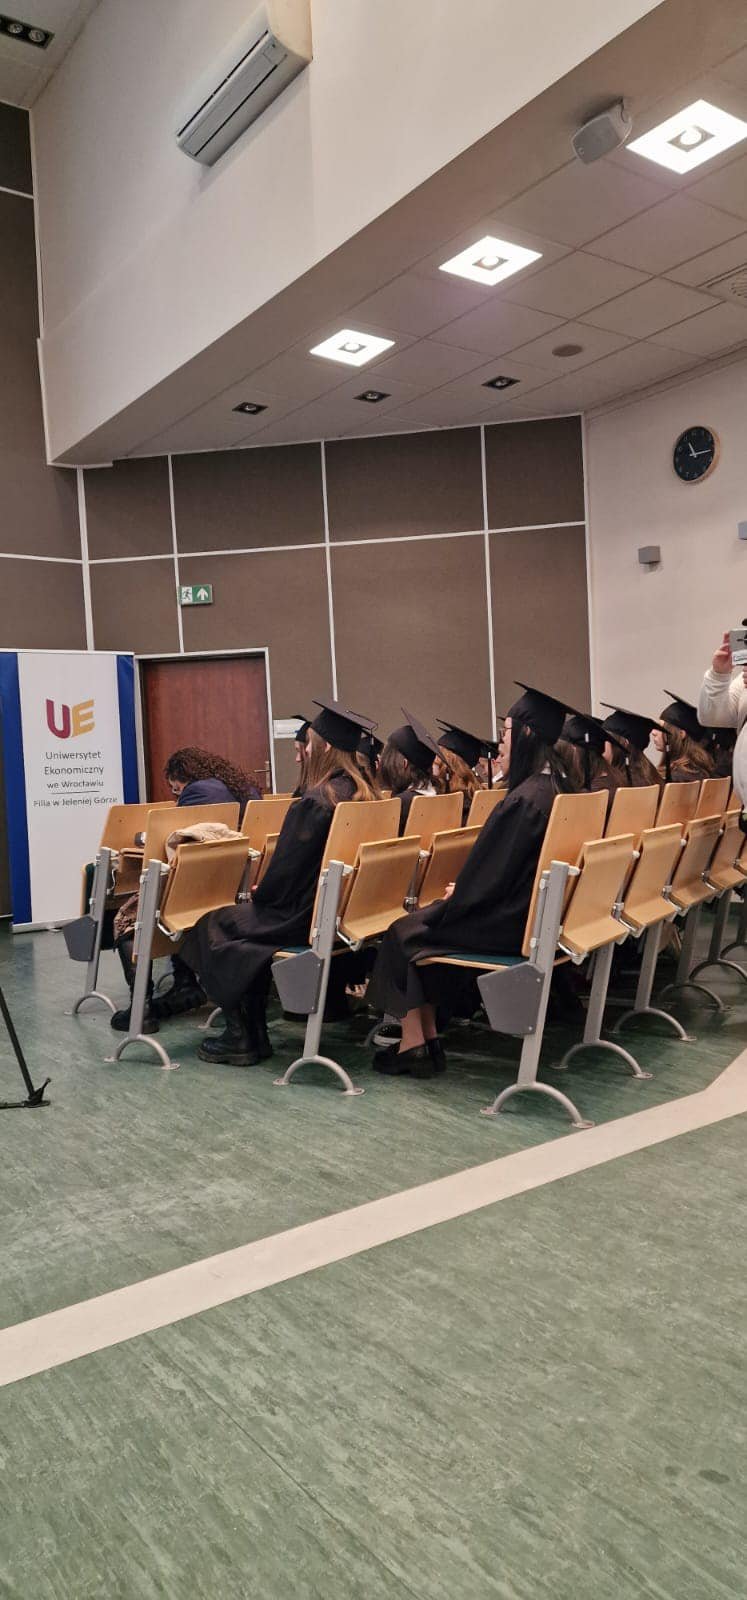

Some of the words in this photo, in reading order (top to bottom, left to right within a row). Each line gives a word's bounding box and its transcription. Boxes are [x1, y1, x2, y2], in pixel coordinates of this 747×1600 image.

[46, 698, 95, 739] UE
[45, 751, 101, 760] Uniwersytet
[44, 766, 104, 775] Ekonomiczny
[61, 780, 104, 788] Wrocławiu
[62, 797, 92, 806] Jeleniej
